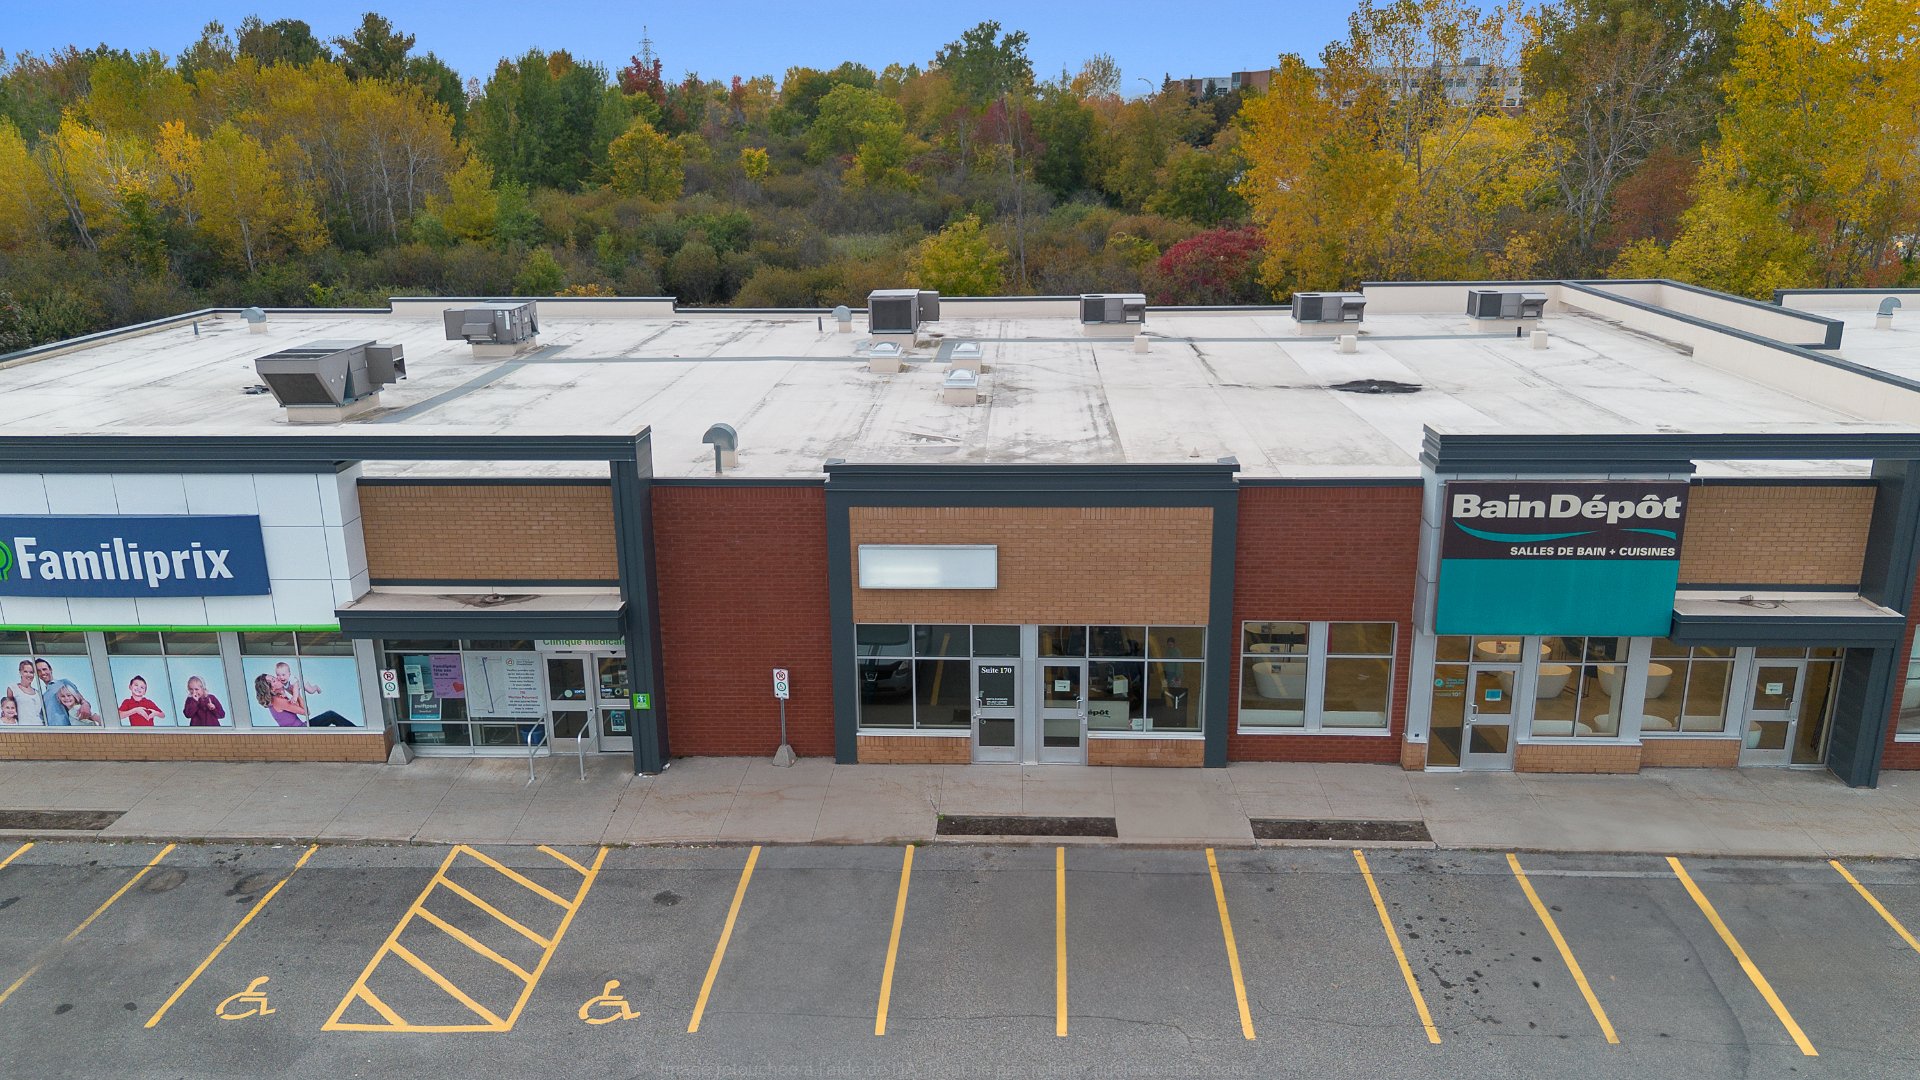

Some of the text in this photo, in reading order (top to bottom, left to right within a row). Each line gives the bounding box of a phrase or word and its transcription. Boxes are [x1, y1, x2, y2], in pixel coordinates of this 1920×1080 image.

[1452, 494, 1681, 524] Bain Dépôt
[1510, 546, 1554, 556] SALLES
[1557, 547, 1573, 556] DE
[1576, 547, 1606, 556] BAIN
[1619, 547, 1675, 557] CUISINES
[13, 537, 234, 588] Familiprix
[1087, 709, 1110, 717] épôt
